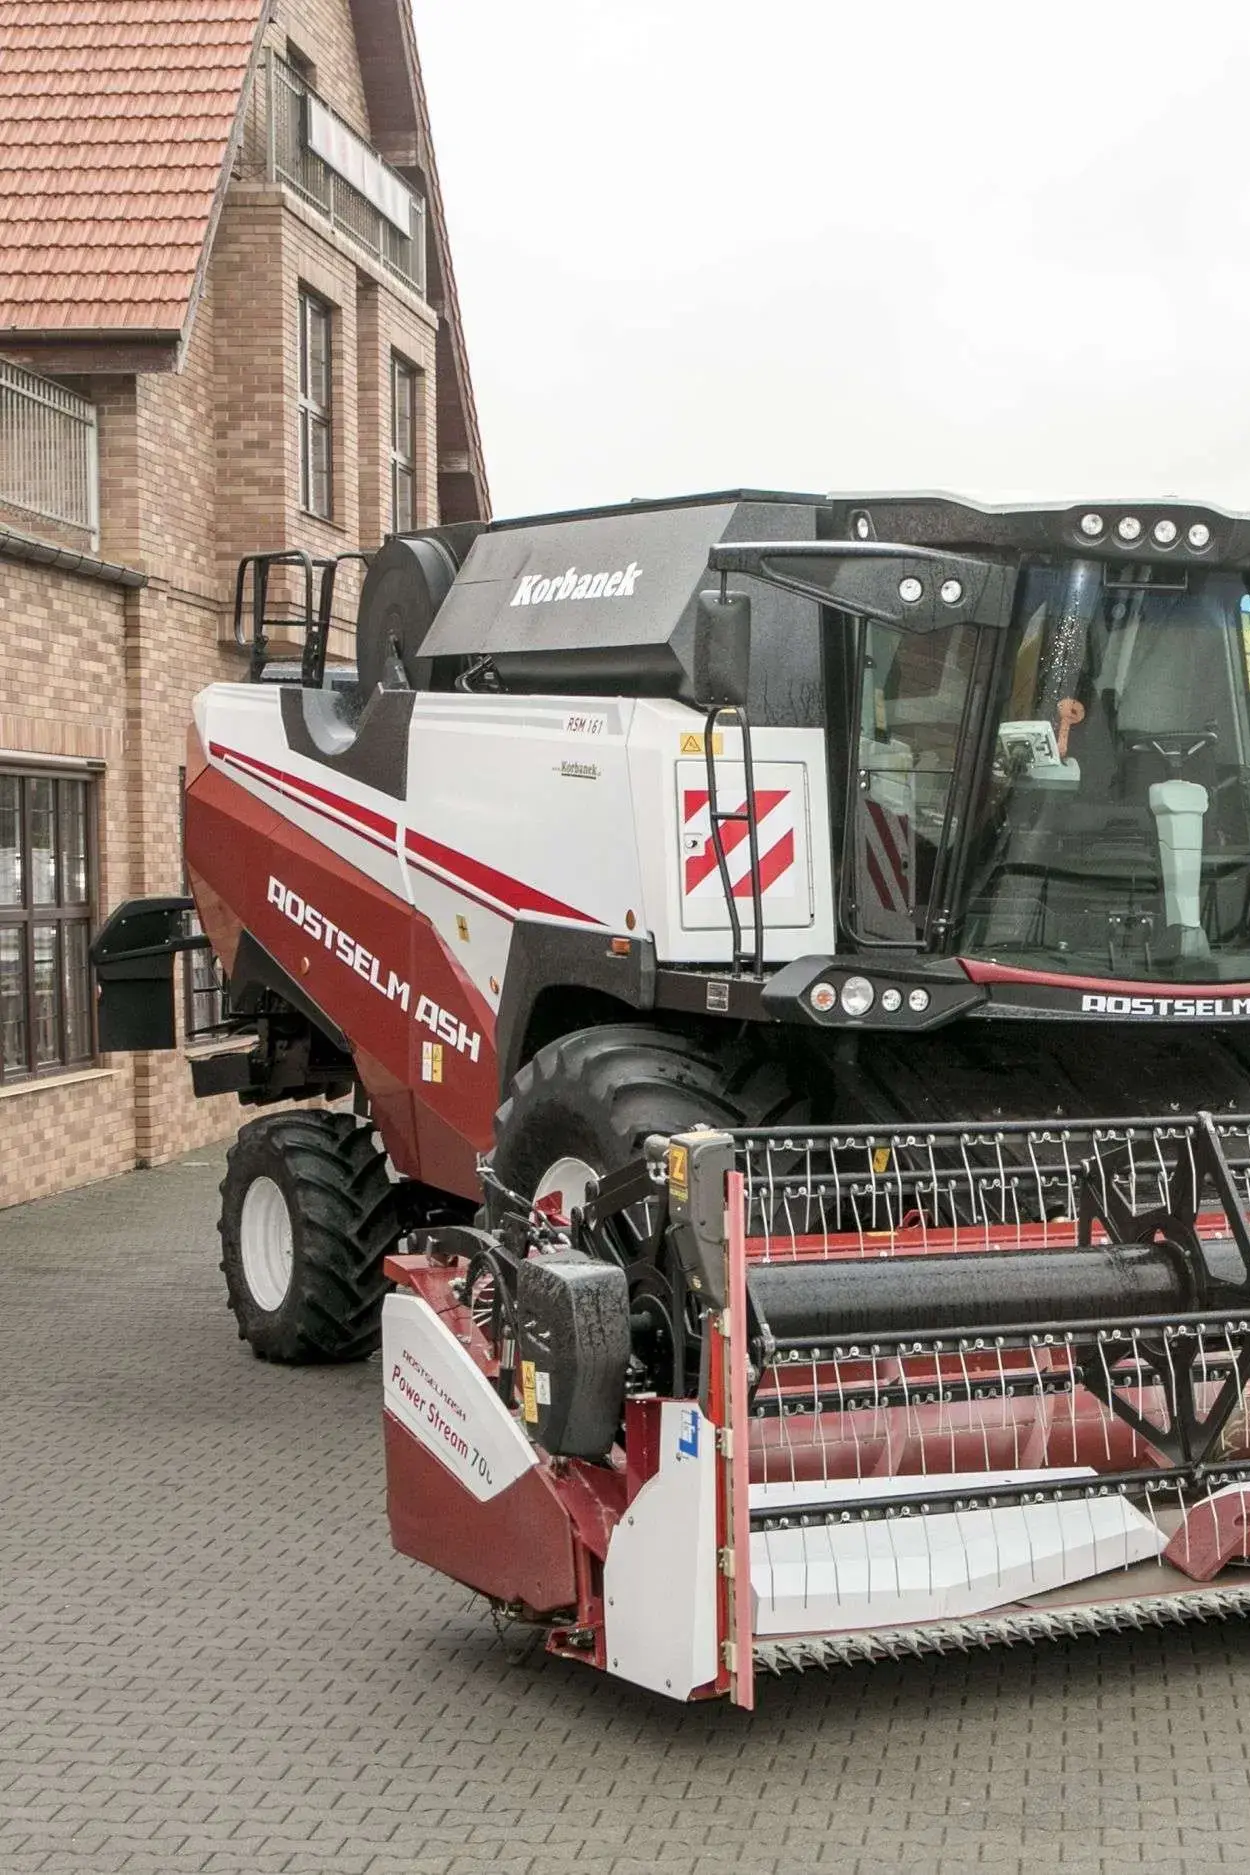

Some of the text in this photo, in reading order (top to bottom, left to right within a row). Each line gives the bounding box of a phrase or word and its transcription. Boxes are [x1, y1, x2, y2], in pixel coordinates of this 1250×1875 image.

[510, 561, 643, 607] Korbanek
[566, 717, 603, 735] RSM 161
[391, 1364, 426, 1411] Power
[427, 1402, 469, 1459] Stream
